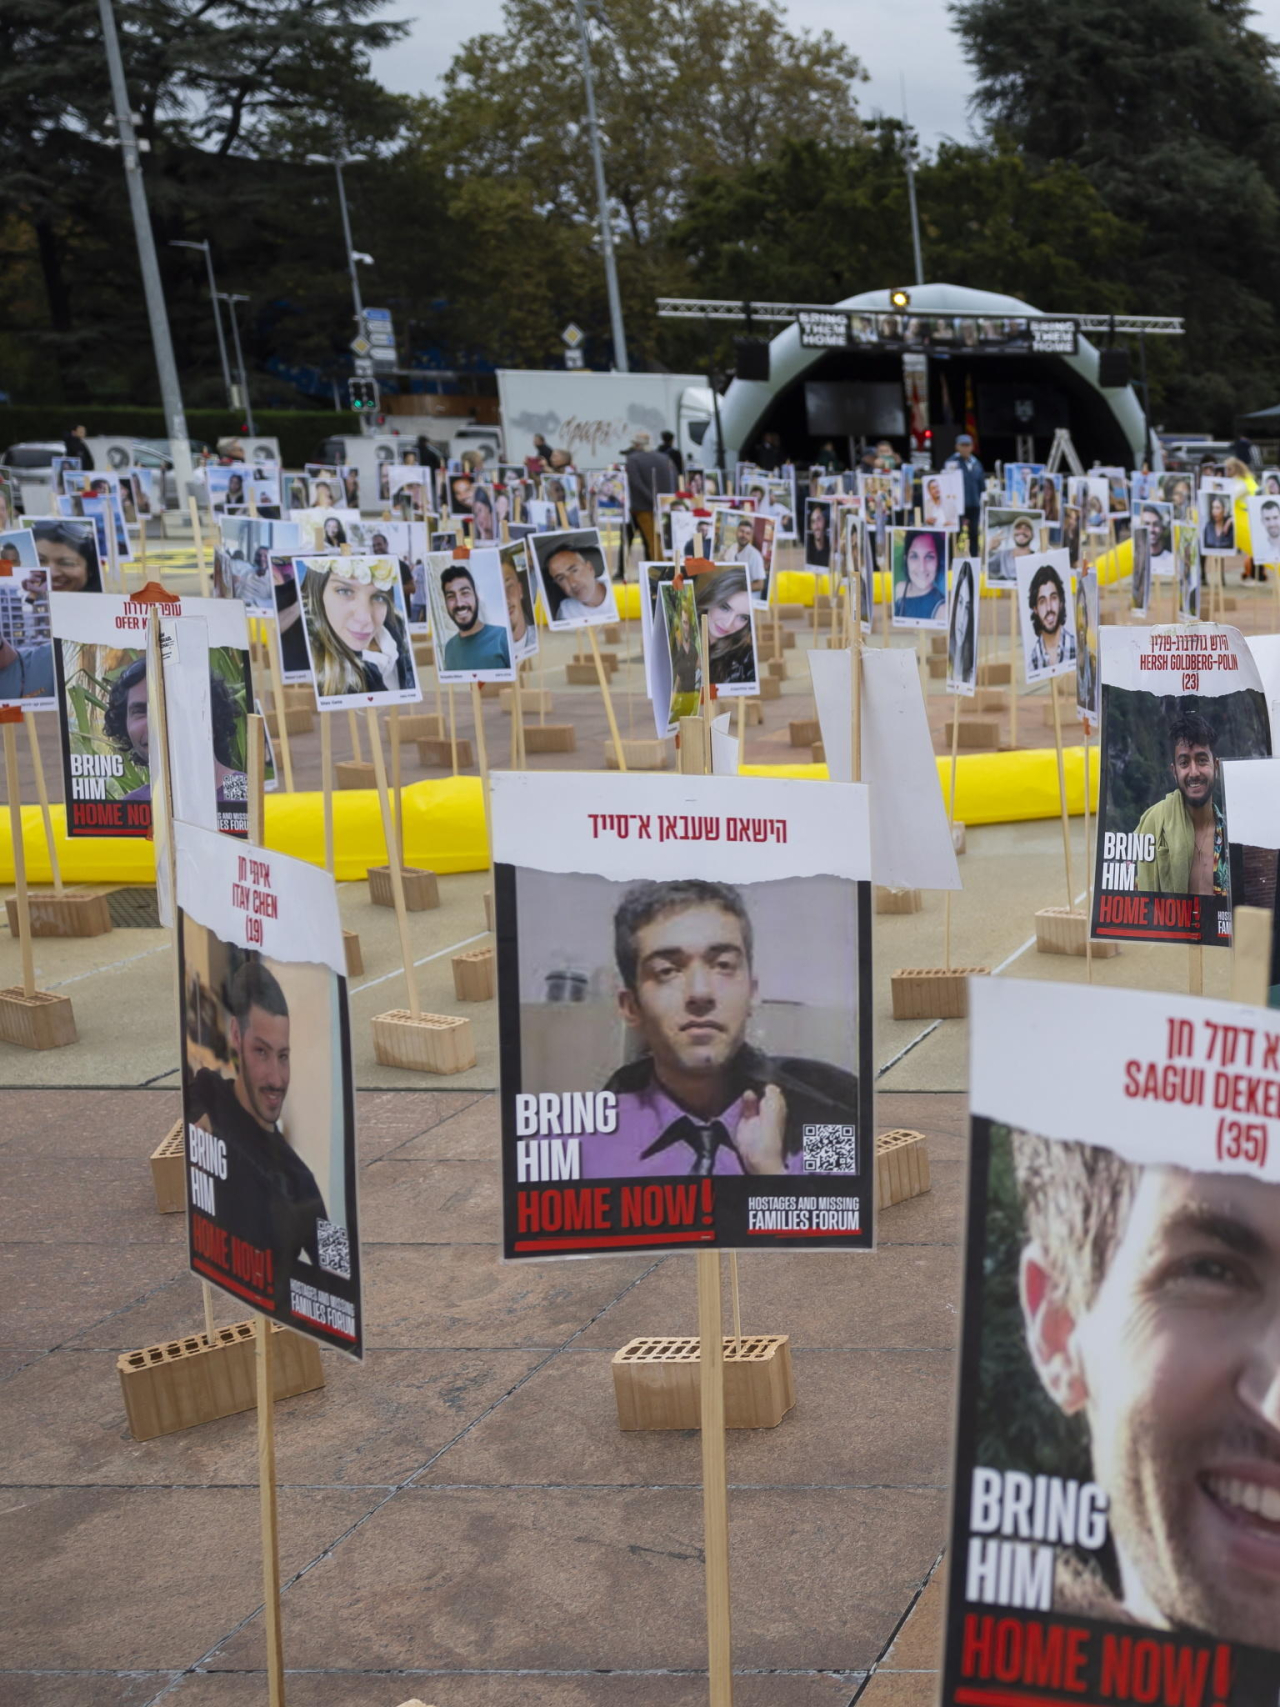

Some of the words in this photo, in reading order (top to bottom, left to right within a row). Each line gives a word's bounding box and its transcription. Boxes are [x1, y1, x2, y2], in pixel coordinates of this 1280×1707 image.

[800, 312, 848, 325] BRING
[803, 324, 847, 336] THEM
[1030, 320, 1075, 332] BRING
[802, 334, 847, 346] HOME
[1032, 341, 1075, 352] HOME
[1034, 331, 1074, 342] THEM
[115, 616, 139, 630] OFER
[159, 603, 182, 616] עופר
[1210, 634, 1229, 651] הירש
[1140, 654, 1168, 670] HERSH
[1170, 654, 1238, 671] GOLDBERG-POLIN
[1182, 673, 1200, 691] (23)
[71, 754, 124, 777] BRING
[72, 778, 107, 800] HIM
[72, 803, 123, 826] HOME
[127, 803, 150, 826] NO
[657, 815, 720, 842] שעבאן
[726, 816, 787, 844] הישאם
[1103, 831, 1155, 862] BRING
[238, 855, 247, 883] חן
[249, 859, 271, 888] איתי
[1102, 861, 1136, 892] HIM
[232, 882, 251, 911] ITAY
[252, 889, 279, 920] CHEN
[1100, 895, 1150, 926] HOME
[1153, 896, 1200, 929] NOW!
[246, 914, 264, 947] (19)
[1166, 1017, 1194, 1060] חן
[1204, 1018, 1255, 1066] דקל
[1125, 1059, 1205, 1107] SAGUI
[515, 1090, 619, 1137] BRING
[188, 1122, 228, 1181] BRING
[1215, 1118, 1270, 1168] (35)
[516, 1138, 582, 1183] HIM
[190, 1166, 216, 1217] HIM
[517, 1187, 611, 1234] HOME
[620, 1178, 716, 1227] NOW!
[748, 1196, 797, 1210] HOSTAGES
[798, 1196, 817, 1210] AND
[818, 1196, 860, 1210] MISSING
[748, 1210, 809, 1231] FAMILIES
[812, 1210, 860, 1231] FORUM
[192, 1213, 229, 1270] HOME
[232, 1235, 274, 1295] NOW!
[291, 1292, 326, 1325] FAMILIES
[327, 1307, 356, 1337] FORUM
[969, 1466, 1110, 1550] BRING
[966, 1537, 1055, 1612] HIM
[961, 1613, 1090, 1693] HOME
[1099, 1632, 1233, 1707] NOW!
